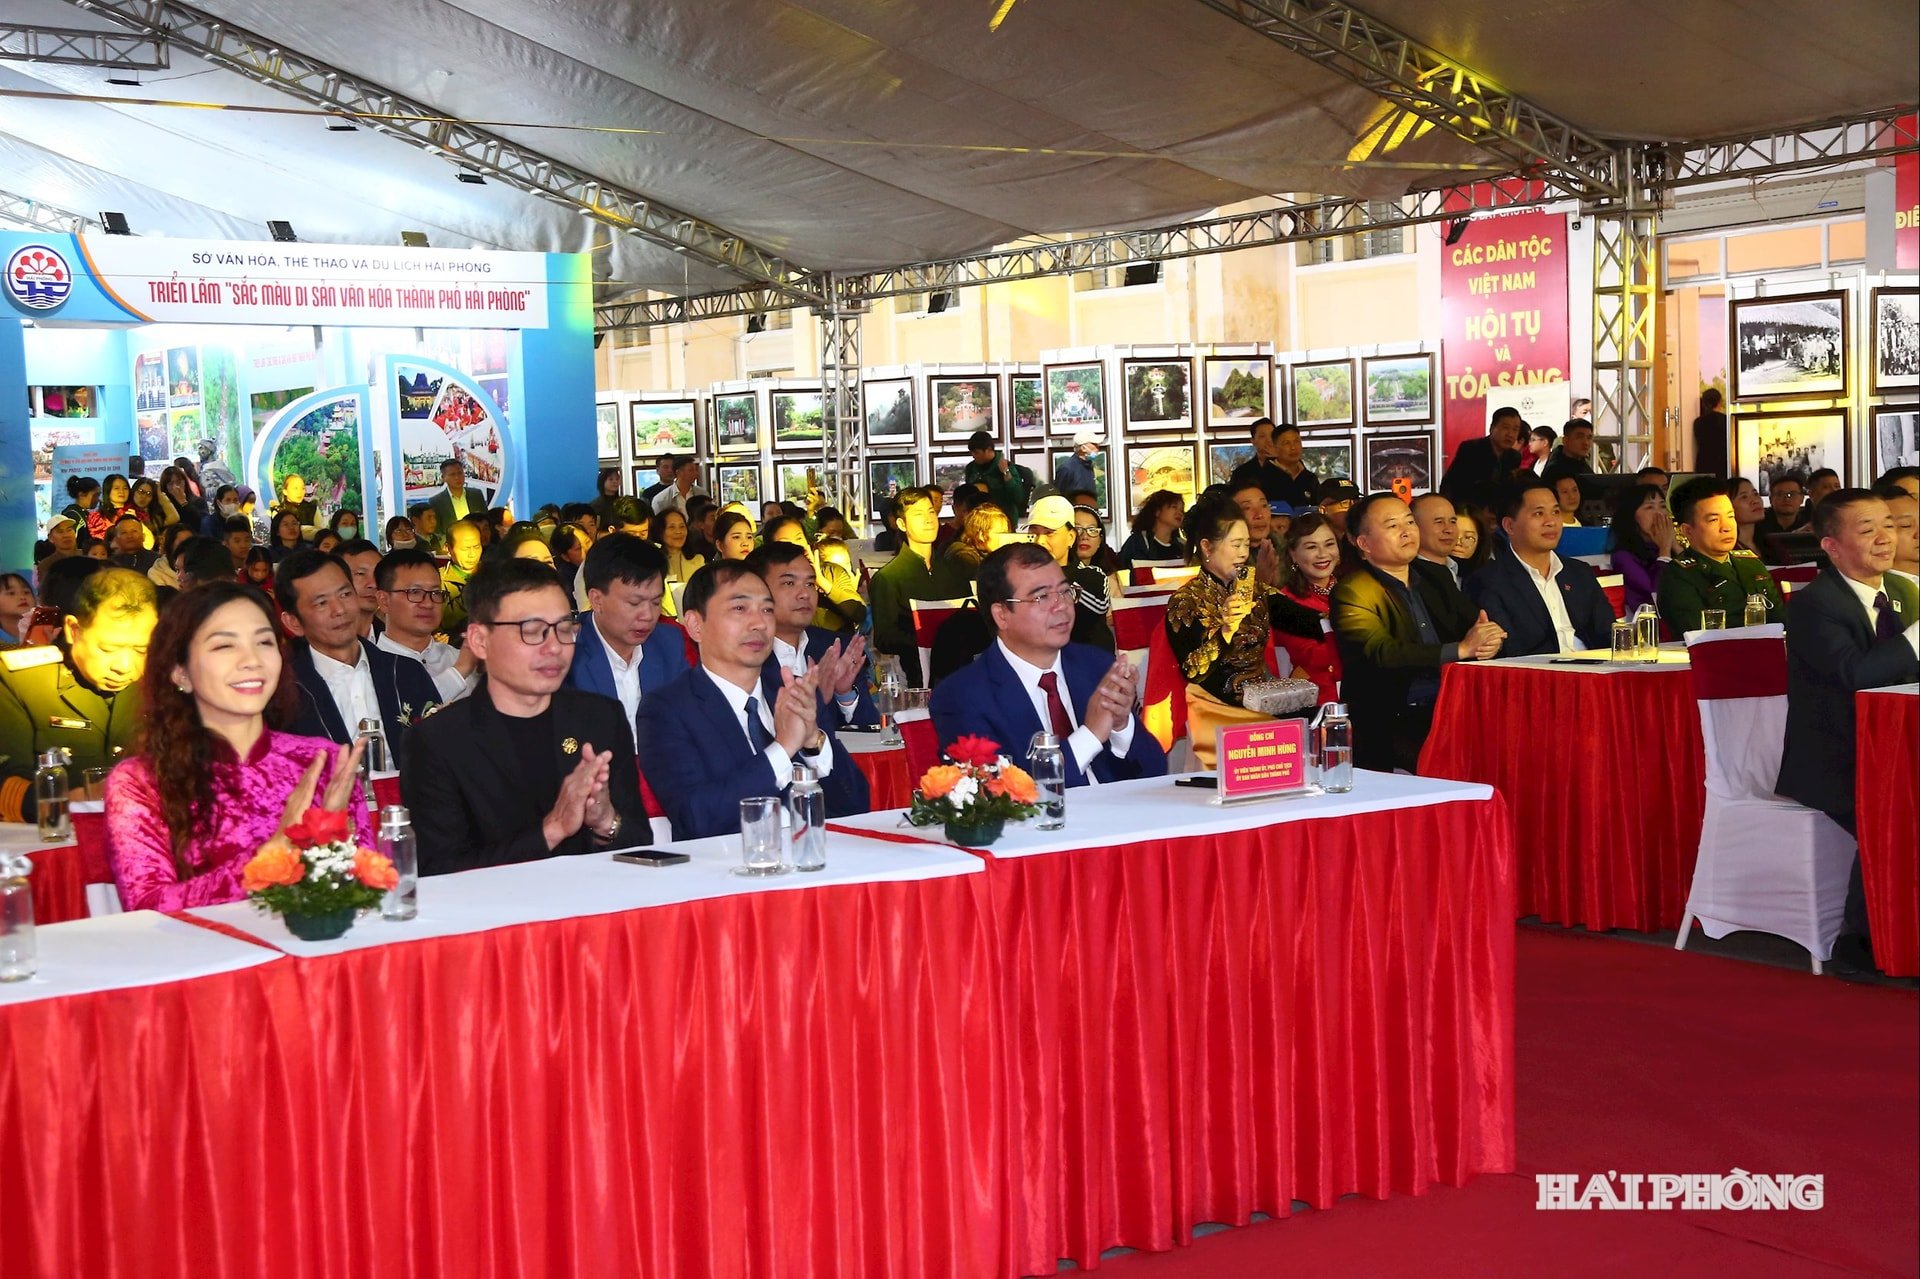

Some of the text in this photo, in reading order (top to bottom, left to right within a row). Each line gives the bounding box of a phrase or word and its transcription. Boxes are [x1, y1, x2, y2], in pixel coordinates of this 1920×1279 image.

[313, 257, 348, 269] THAO
[372, 259, 389, 270] DU
[1452, 234, 1552, 266] CÁC DÂN TỘC
[148, 271, 188, 304] TRIỂN
[191, 277, 222, 304] LÃM
[262, 281, 292, 306] MÀU
[295, 286, 308, 306] DI
[312, 279, 337, 307] SẢN
[339, 284, 365, 307] VĂN
[368, 283, 393, 308] HÓA
[396, 284, 435, 309] THÀNH
[439, 281, 462, 309] PHỐ
[465, 281, 484, 310] HẢI
[1468, 270, 1536, 299] VIỆT NAM
[1464, 308, 1541, 347] HỘI TỤ
[1495, 344, 1511, 361] VÀ
[1446, 366, 1491, 400] TỎA
[1257, 745, 1276, 757] MINH
